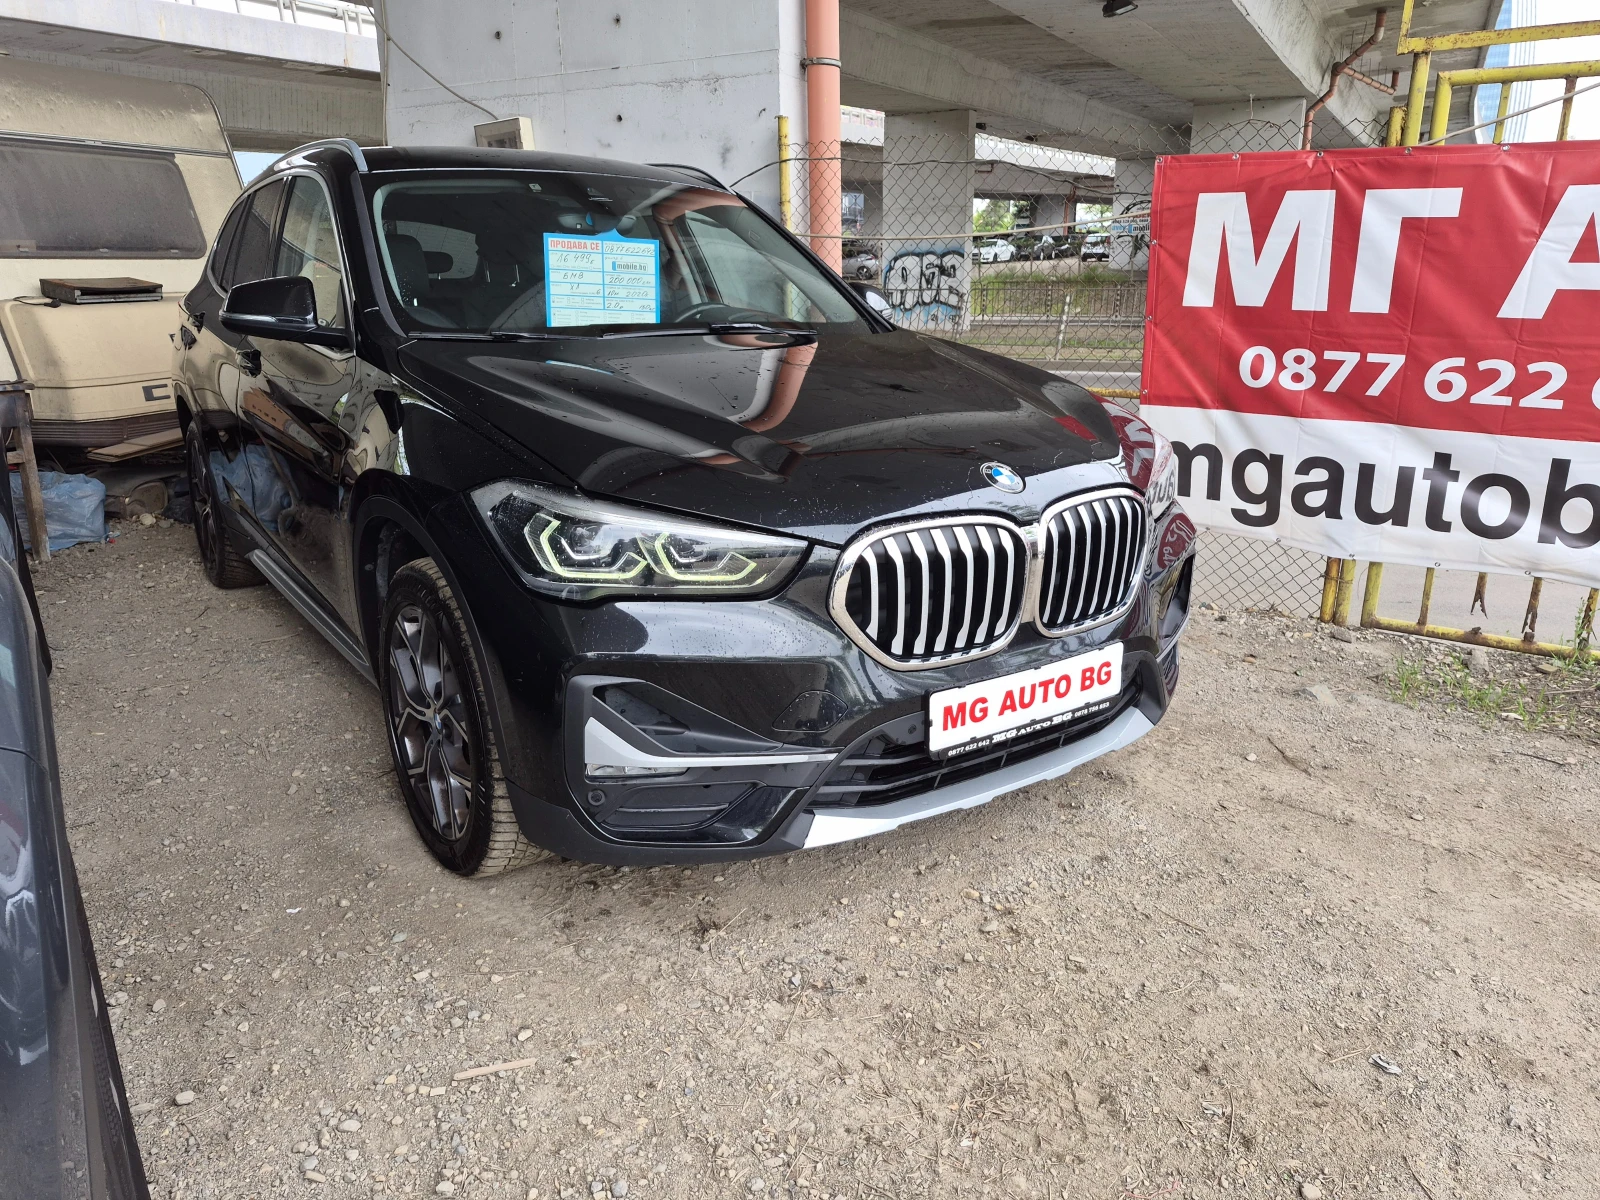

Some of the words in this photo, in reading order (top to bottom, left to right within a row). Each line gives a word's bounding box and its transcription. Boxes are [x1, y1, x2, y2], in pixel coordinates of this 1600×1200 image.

[550, 240, 588, 250] ПРОДАВА
[590, 242, 600, 251] СЕ
[616, 262, 648, 272] mobile.bg
[1183, 187, 1463, 313] МГ
[608, 276, 625, 284] 200
[1239, 346, 1405, 396] 0877
[1424, 358, 1567, 409] 622
[1171, 440, 1600, 549] mgautob
[942, 697, 988, 731] MG
[998, 674, 1072, 717] AUTO
[1080, 661, 1112, 692] BG
[948, 746, 964, 757] 0877
[992, 728, 1017, 743] MG
[1018, 720, 1051, 735] AUTO
[1052, 711, 1072, 725] BG
